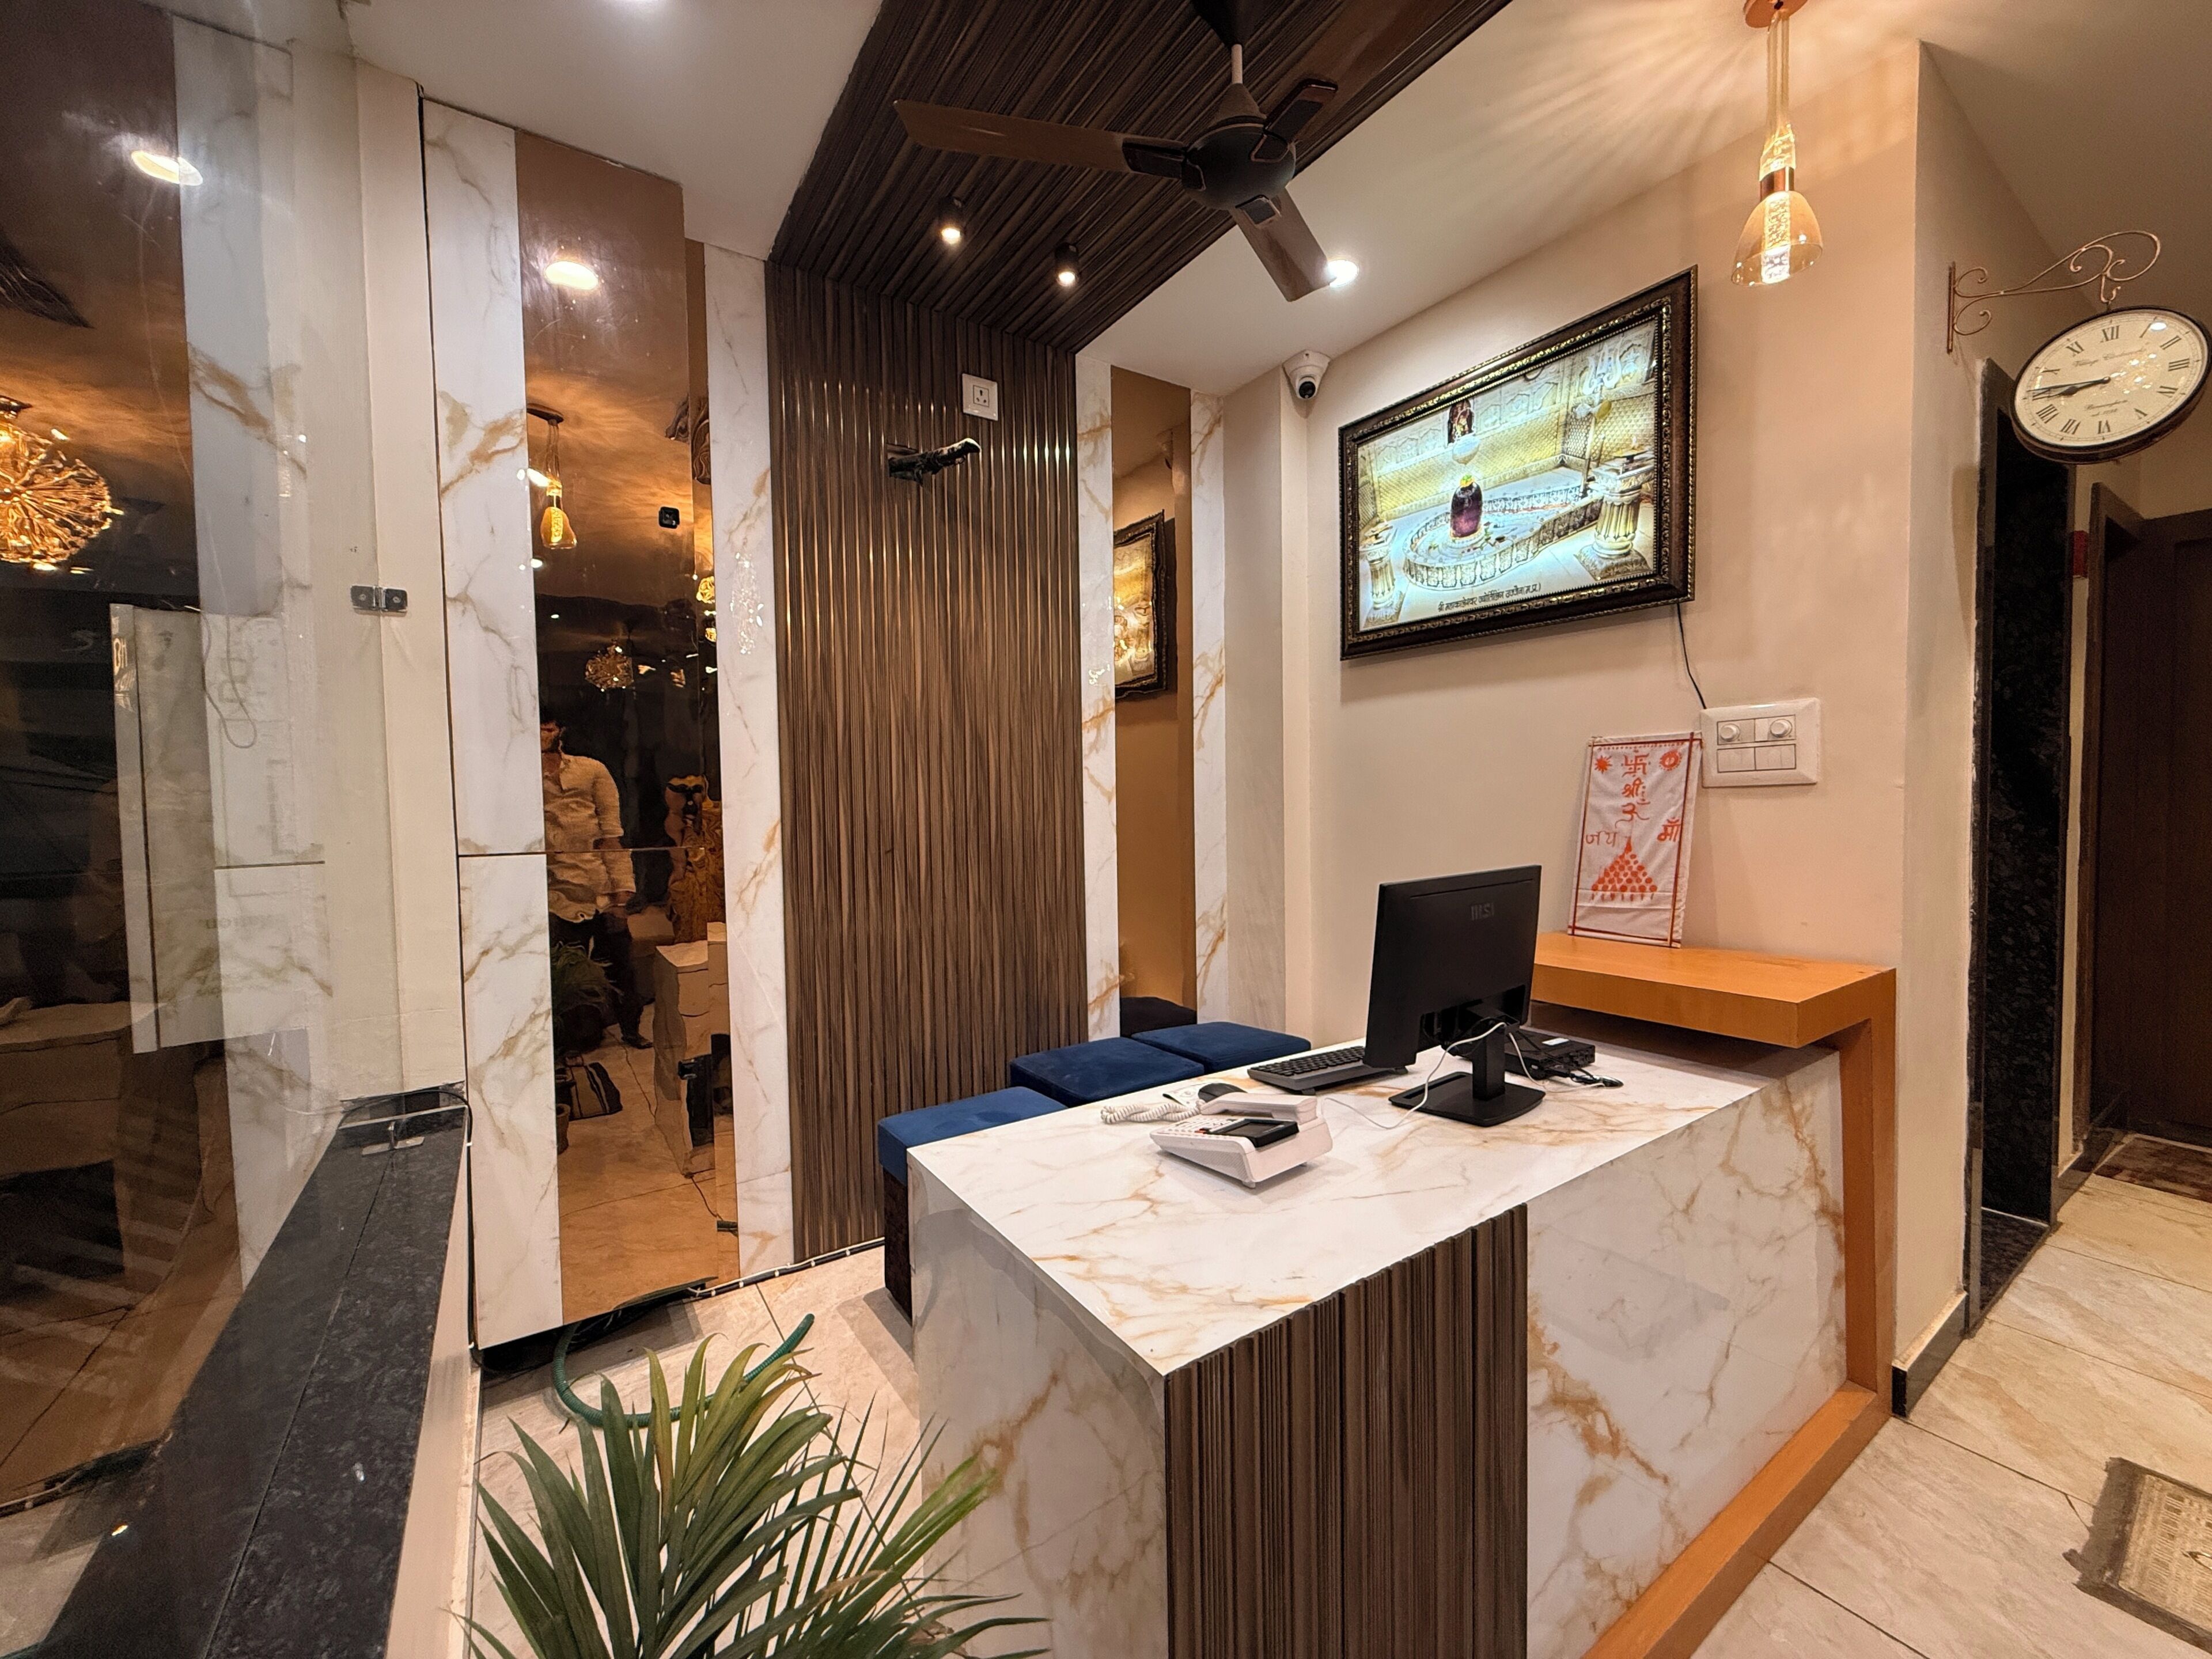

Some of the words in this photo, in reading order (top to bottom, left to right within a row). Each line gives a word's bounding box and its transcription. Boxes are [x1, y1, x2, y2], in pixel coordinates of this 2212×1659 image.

[2100, 325, 2120, 343] XII
[2066, 341, 2085, 357] XI
[2160, 335, 2182, 350] II
[2168, 358, 2190, 372] III
[2036, 404, 2059, 424] VIII
[2060, 419, 2081, 435] VII
[2097, 419, 2111, 434] VI
[1586, 830, 1618, 847] जय
